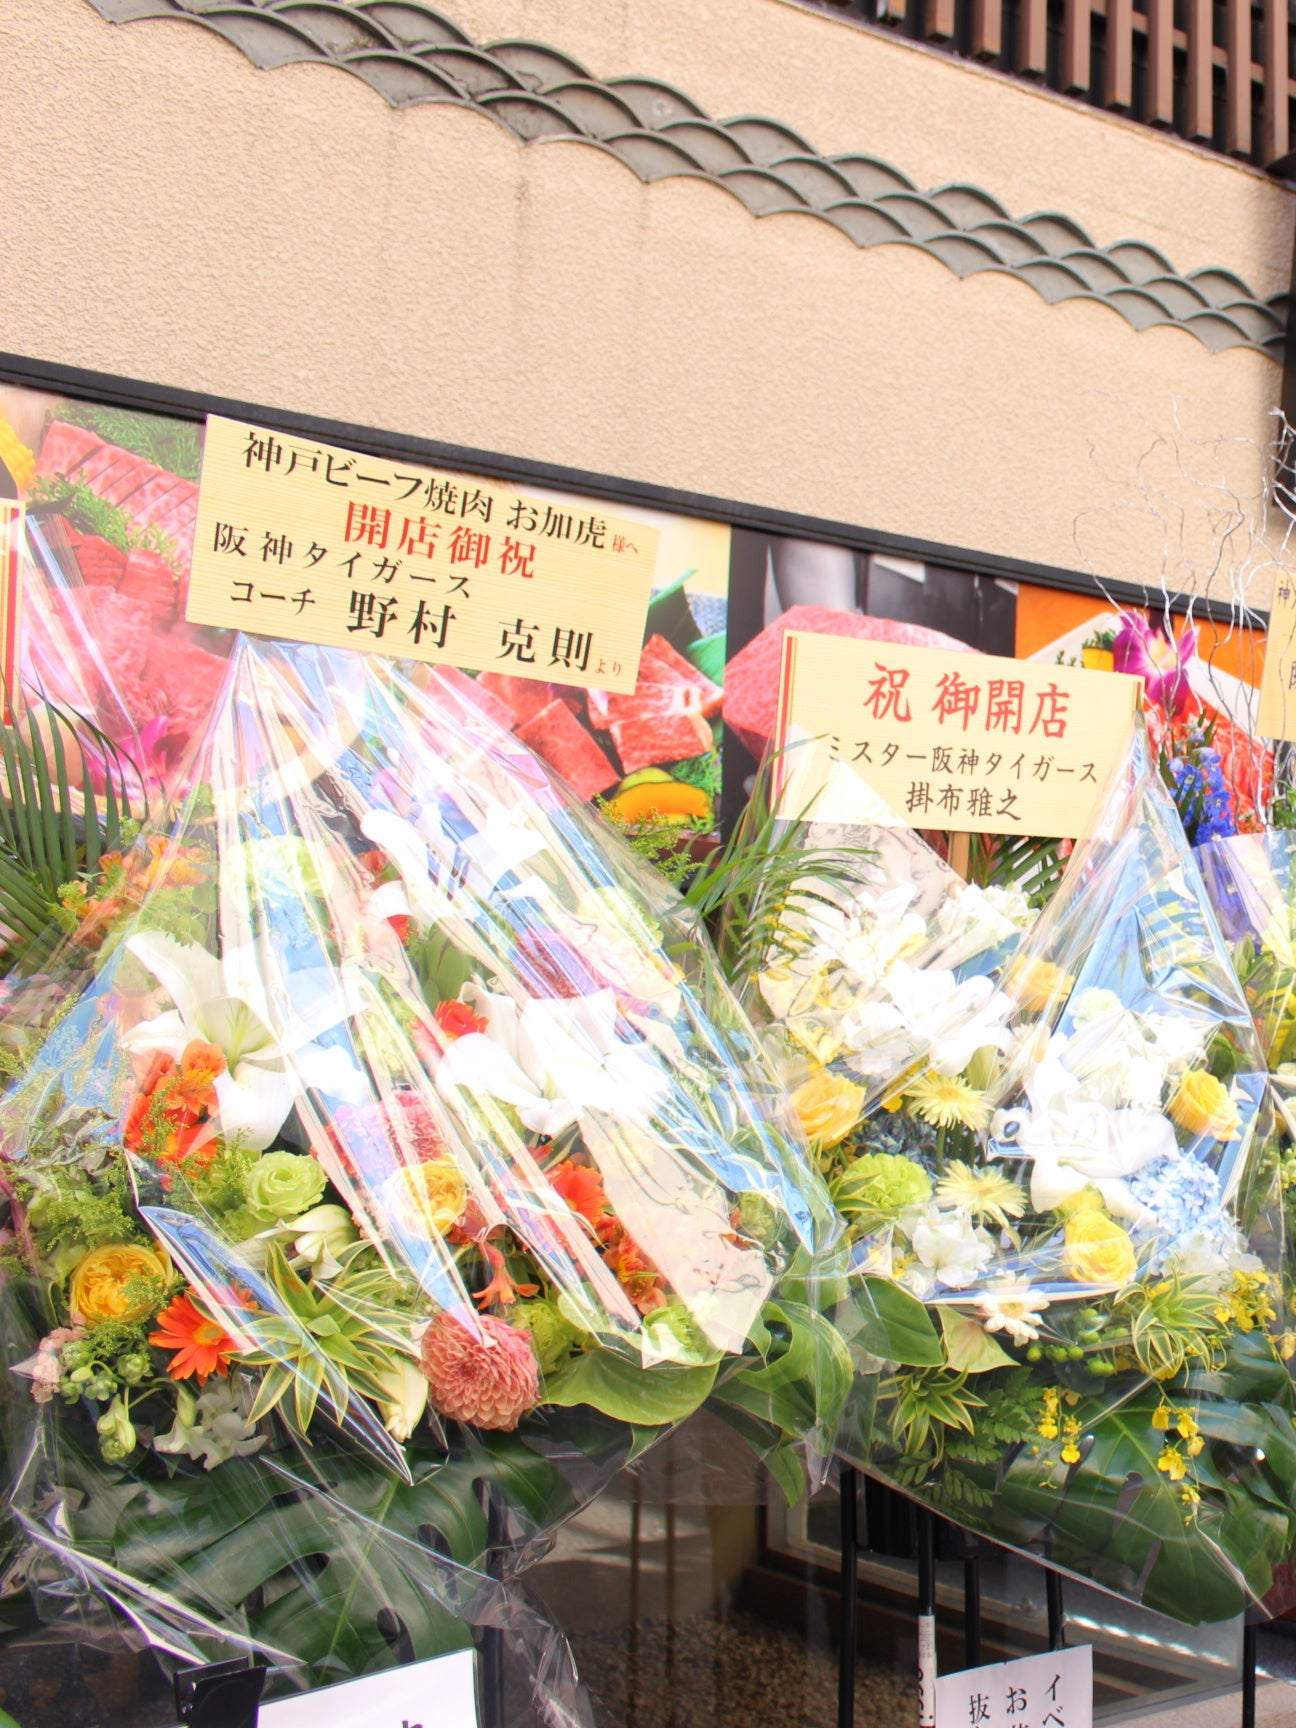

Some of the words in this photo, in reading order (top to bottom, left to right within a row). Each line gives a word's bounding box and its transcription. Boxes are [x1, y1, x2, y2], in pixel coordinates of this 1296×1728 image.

[241, 431, 493, 524] 神戸ビーフ焼肉
[213, 522, 471, 599] 阪神タイガース
[343, 500, 535, 579] 開店御祝
[230, 579, 316, 616] コーチ
[828, 735, 1098, 784] ミスター阪神タイガース
[906, 781, 1023, 822] 掛布雅之
[1006, 1686, 1028, 1728] お
